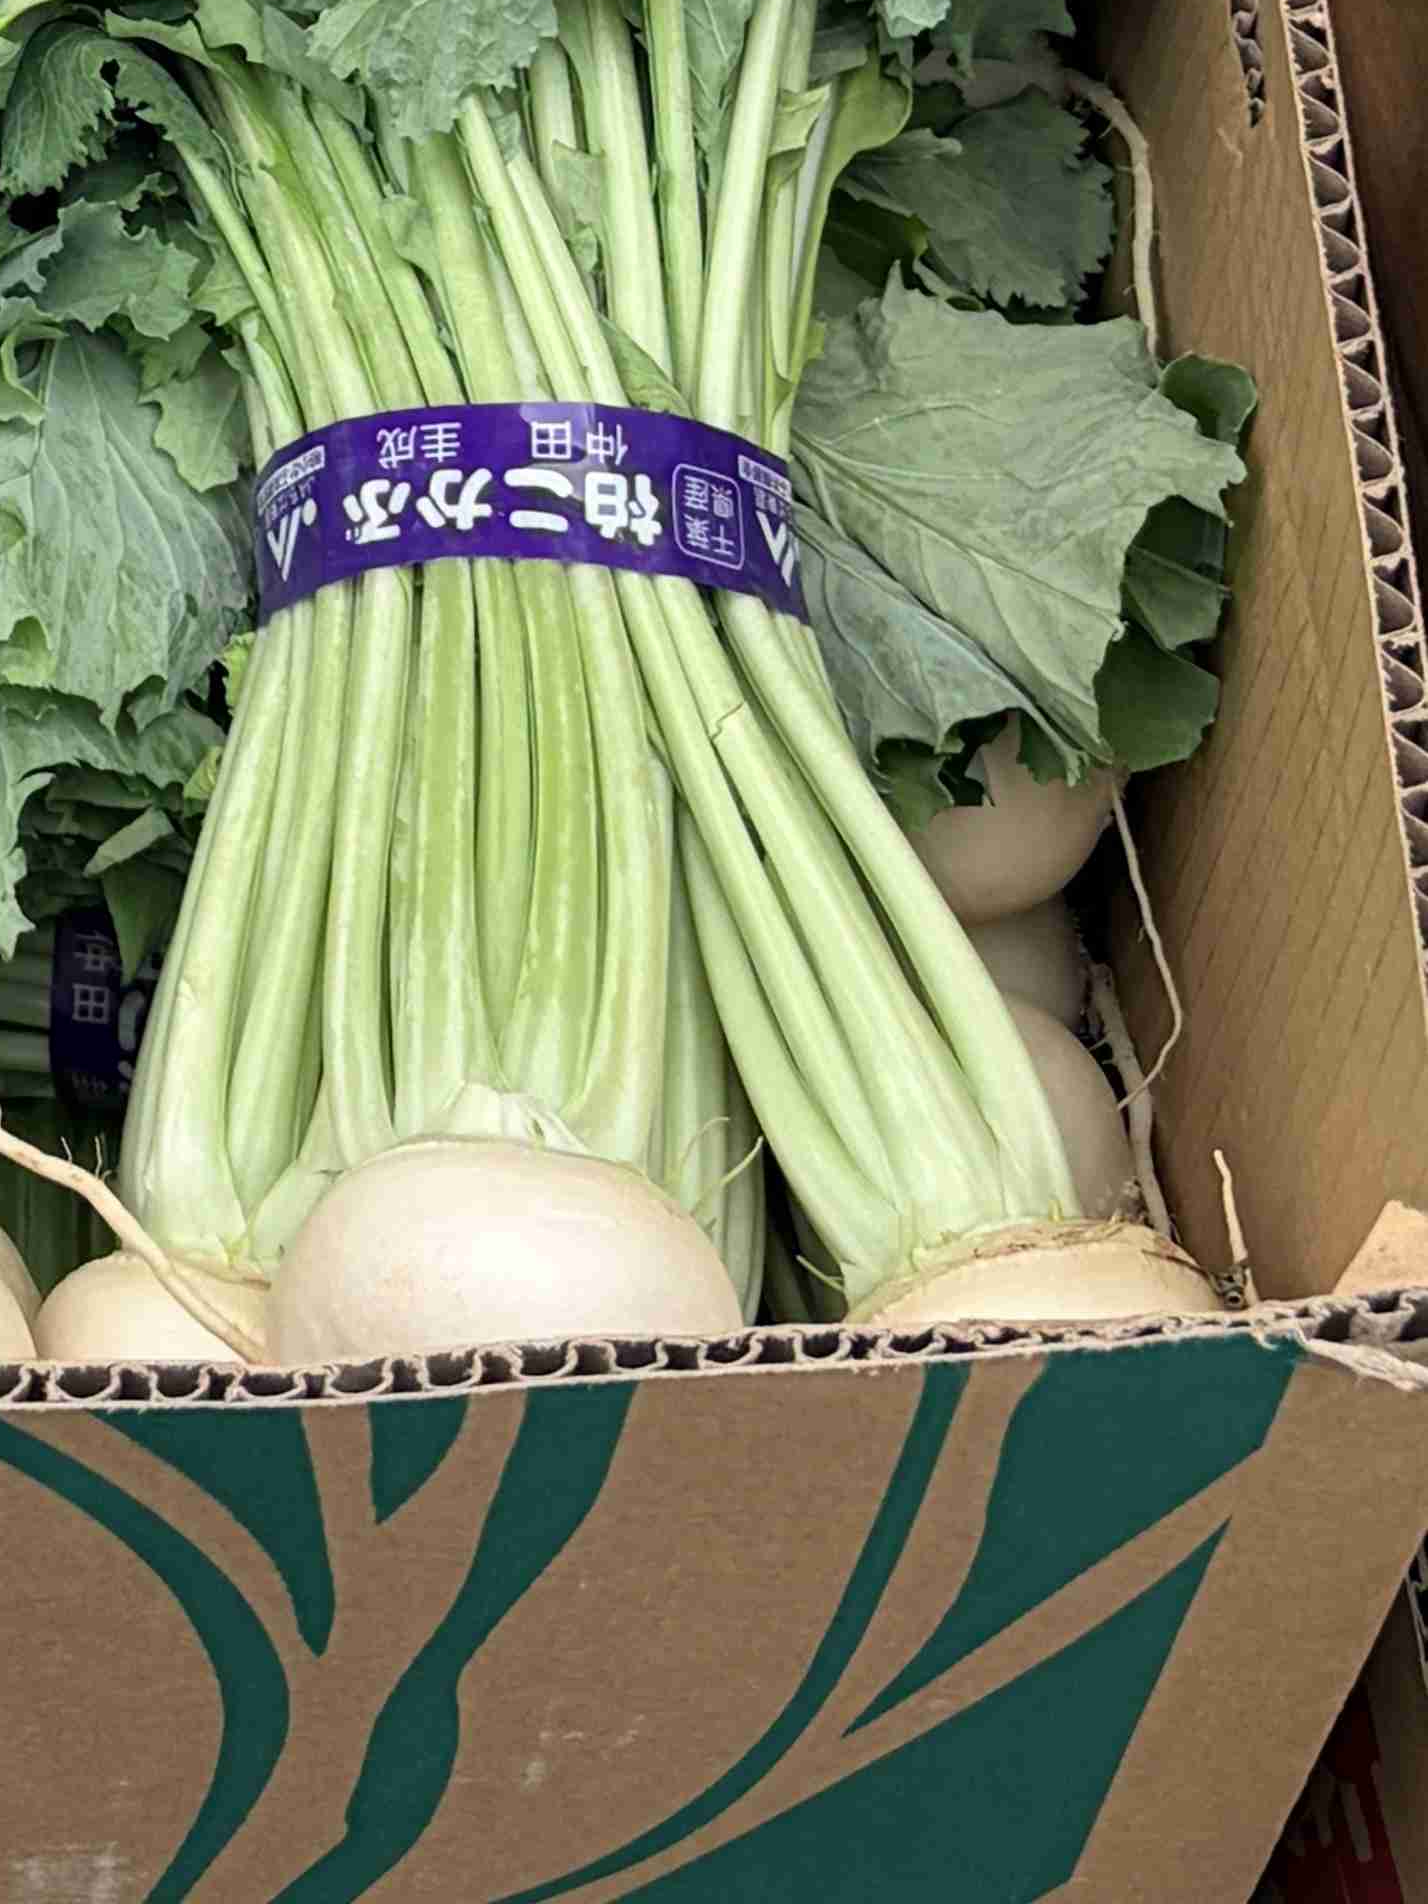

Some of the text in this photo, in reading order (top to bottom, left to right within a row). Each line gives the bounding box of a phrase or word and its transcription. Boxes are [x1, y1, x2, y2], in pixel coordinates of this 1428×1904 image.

[377, 419, 628, 470] 仲田 圭成
[344, 465, 664, 546] 柏こかぶ
